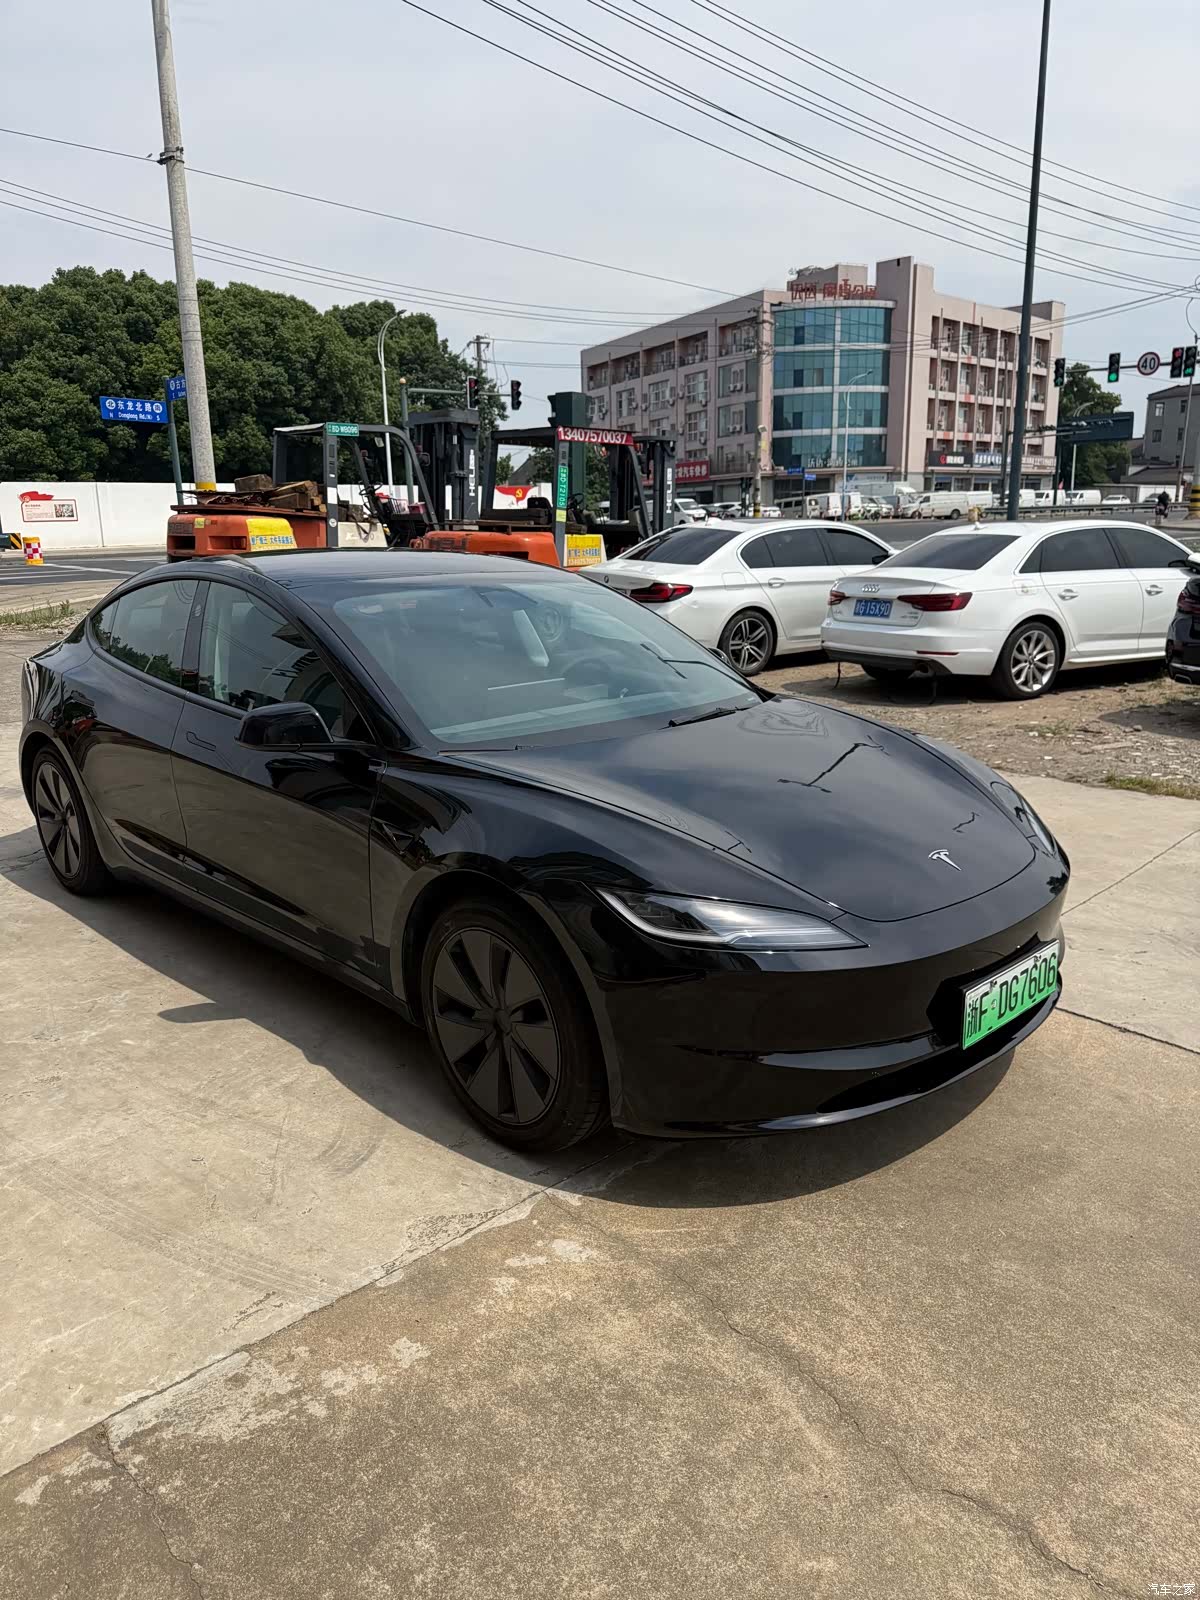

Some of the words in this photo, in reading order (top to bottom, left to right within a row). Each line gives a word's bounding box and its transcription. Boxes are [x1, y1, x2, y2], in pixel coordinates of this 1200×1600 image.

[1141, 356, 1156, 371] 40
[117, 400, 152, 412] 东龙北路
[558, 426, 628, 444] 13407570037
